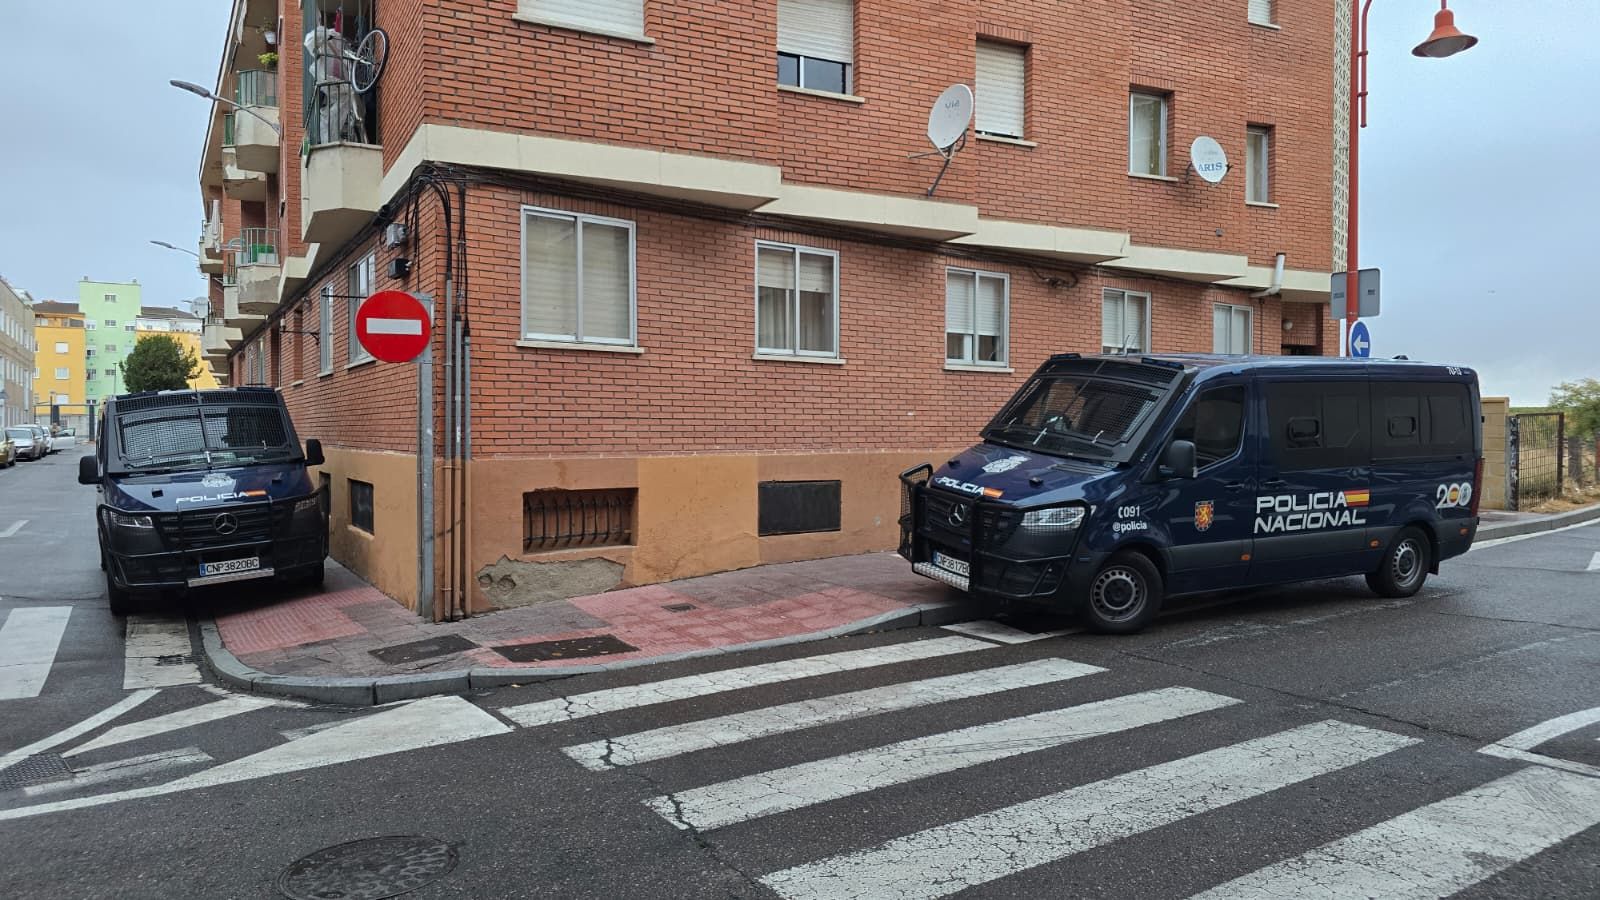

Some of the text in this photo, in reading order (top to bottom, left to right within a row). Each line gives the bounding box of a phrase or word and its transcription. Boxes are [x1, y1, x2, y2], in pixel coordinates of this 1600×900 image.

[1198, 162, 1222, 171] ARIS
[1435, 482, 1472, 509] 200
[1254, 509, 1366, 534] NACIONAL
[206, 558, 258, 573] CNP3820BC
